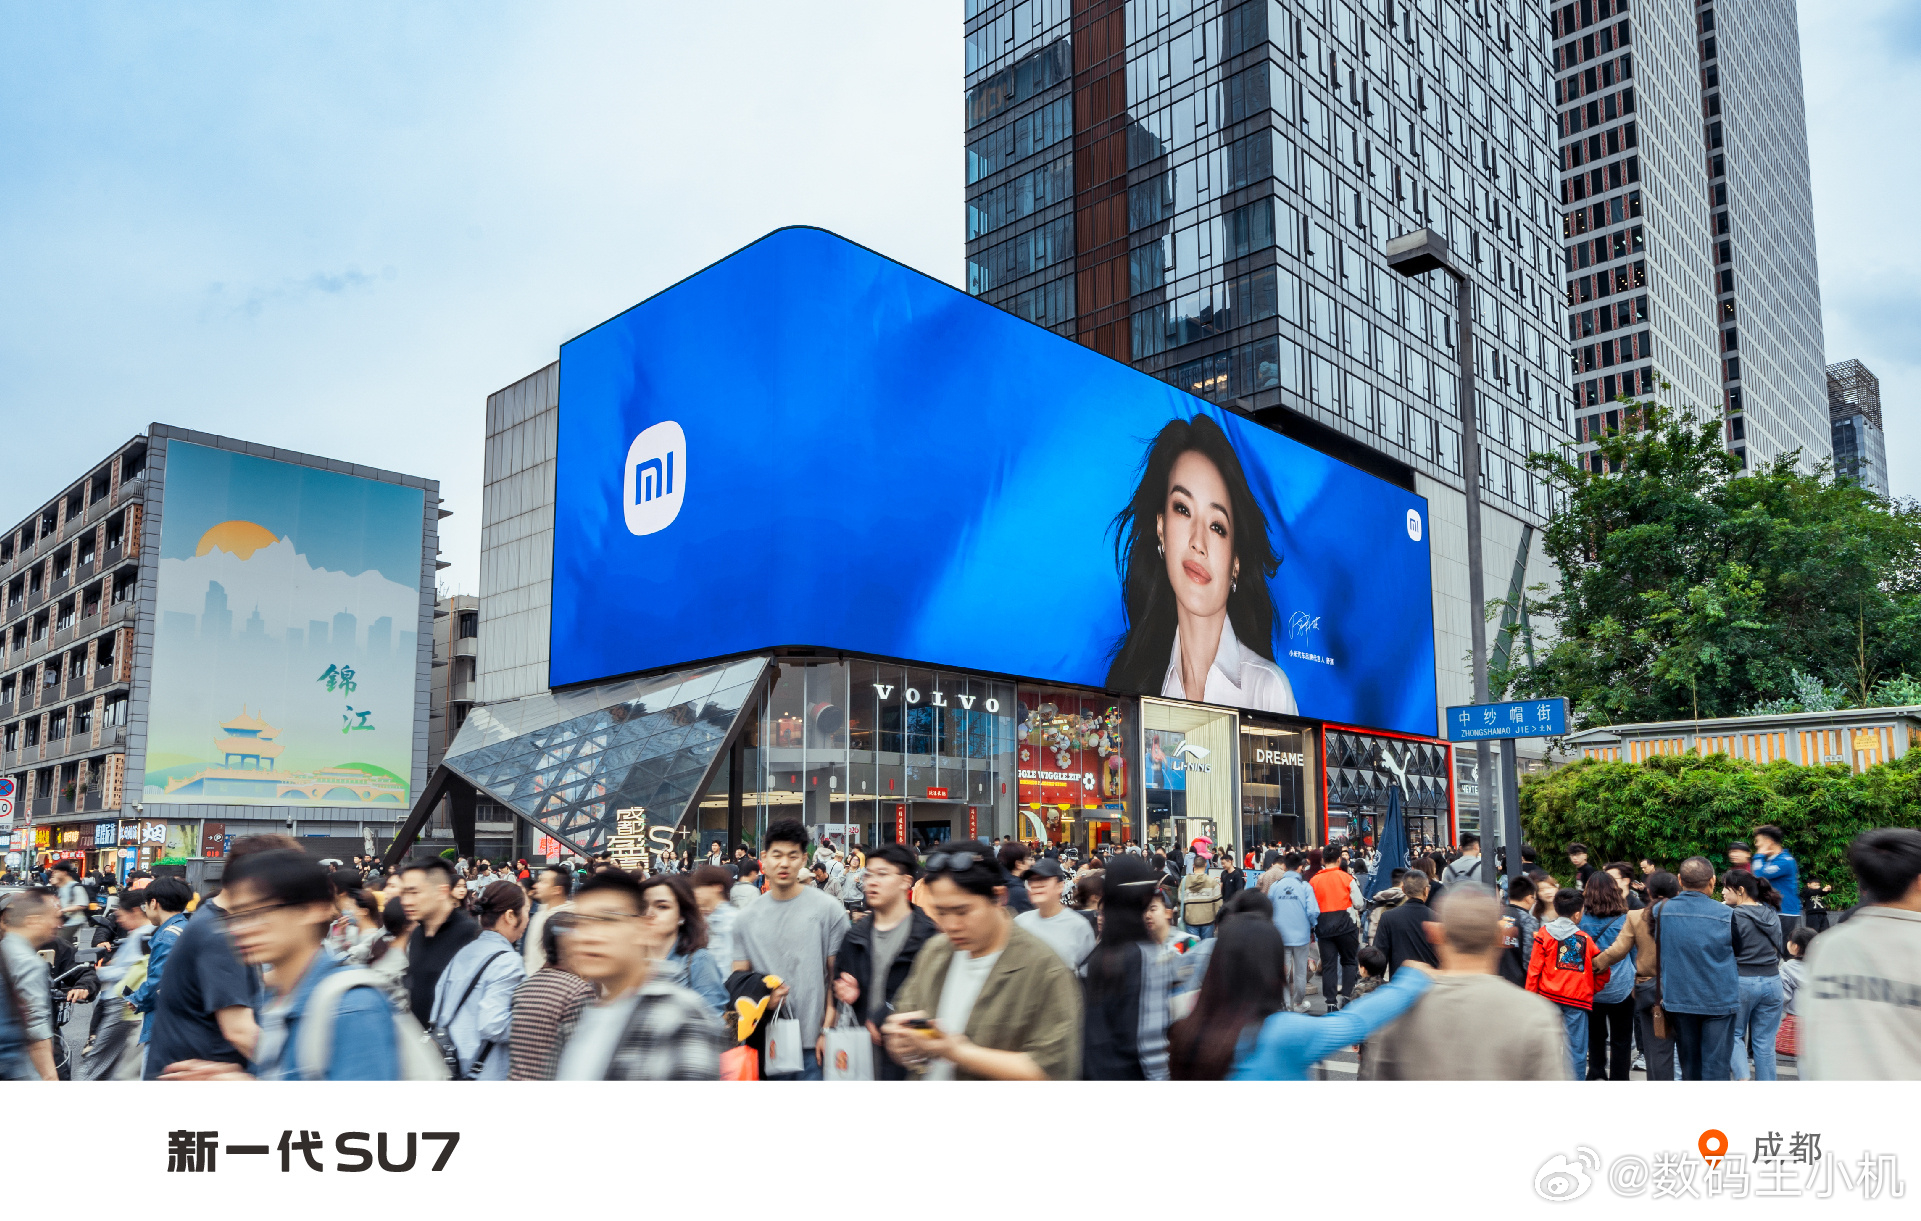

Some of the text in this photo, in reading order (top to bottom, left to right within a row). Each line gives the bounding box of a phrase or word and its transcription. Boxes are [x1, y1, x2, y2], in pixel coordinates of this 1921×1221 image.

[873, 683, 1000, 713] VOLVO
[1458, 703, 1551, 727] 中纱帽街
[1515, 725, 1530, 734] JIE
[1172, 760, 1212, 774] LI-NING
[1256, 748, 1304, 767] DREAME
[141, 821, 167, 844] 烟
